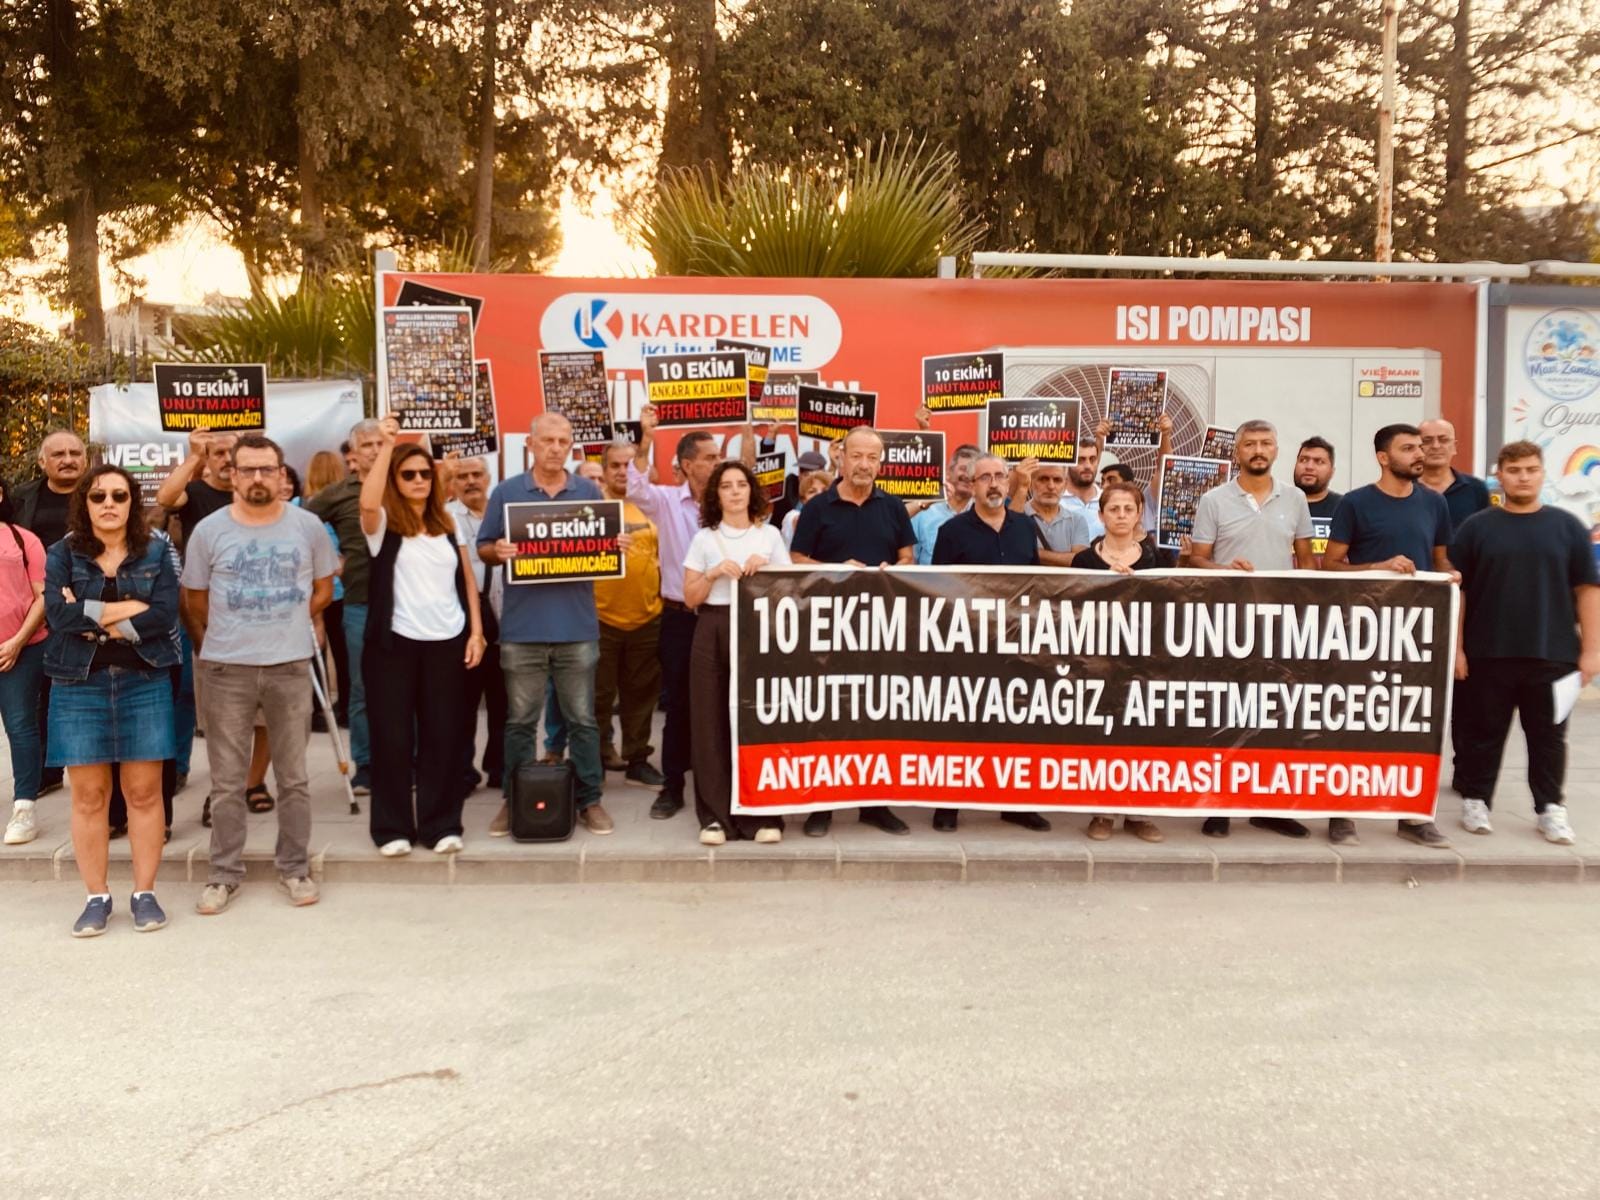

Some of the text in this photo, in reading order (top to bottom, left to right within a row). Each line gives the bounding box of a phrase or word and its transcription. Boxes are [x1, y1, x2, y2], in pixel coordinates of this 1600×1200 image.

[631, 313, 810, 339] KARDELEN
[1116, 305, 1311, 342] ISI POMPASI
[659, 362, 682, 380] 10
[687, 357, 734, 379] EKİM
[935, 369, 950, 382] 10
[172, 381, 193, 397] 10
[652, 383, 690, 398] ANKARA
[927, 379, 1001, 394] UNUTMADIK!
[1376, 382, 1421, 396] Beretta
[163, 397, 261, 410] UNUTMADIK!
[808, 400, 823, 413] 10
[165, 409, 262, 429] UNUTTURMAYACAĞIZ!
[402, 417, 462, 429] ANKARA
[1000, 414, 1018, 428] 10
[574, 432, 605, 441] KARA
[991, 430, 1076, 441] UNUTMADIK!
[1113, 437, 1152, 445] ANKARA
[991, 441, 1074, 459] UNUTTURMAYACAĞIZ!
[878, 465, 940, 478] UTMADIK!
[875, 478, 940, 496] TTURMAYACAĞIZ!
[526, 522, 548, 539] 10
[516, 538, 618, 555] UNUTMADIK!
[515, 551, 618, 576] UNUTTURMAYACAĞIZ!
[754, 595, 799, 654] 10
[1164, 602, 1434, 663] UNUTMADIK!
[756, 664, 1432, 736] UNUTTURMAYACAĞIZ, AFFETMEYECEĞİZ!
[757, 753, 1424, 798] ANTAKYA EMEK VE DEMOKRASİ PLATFORMU
